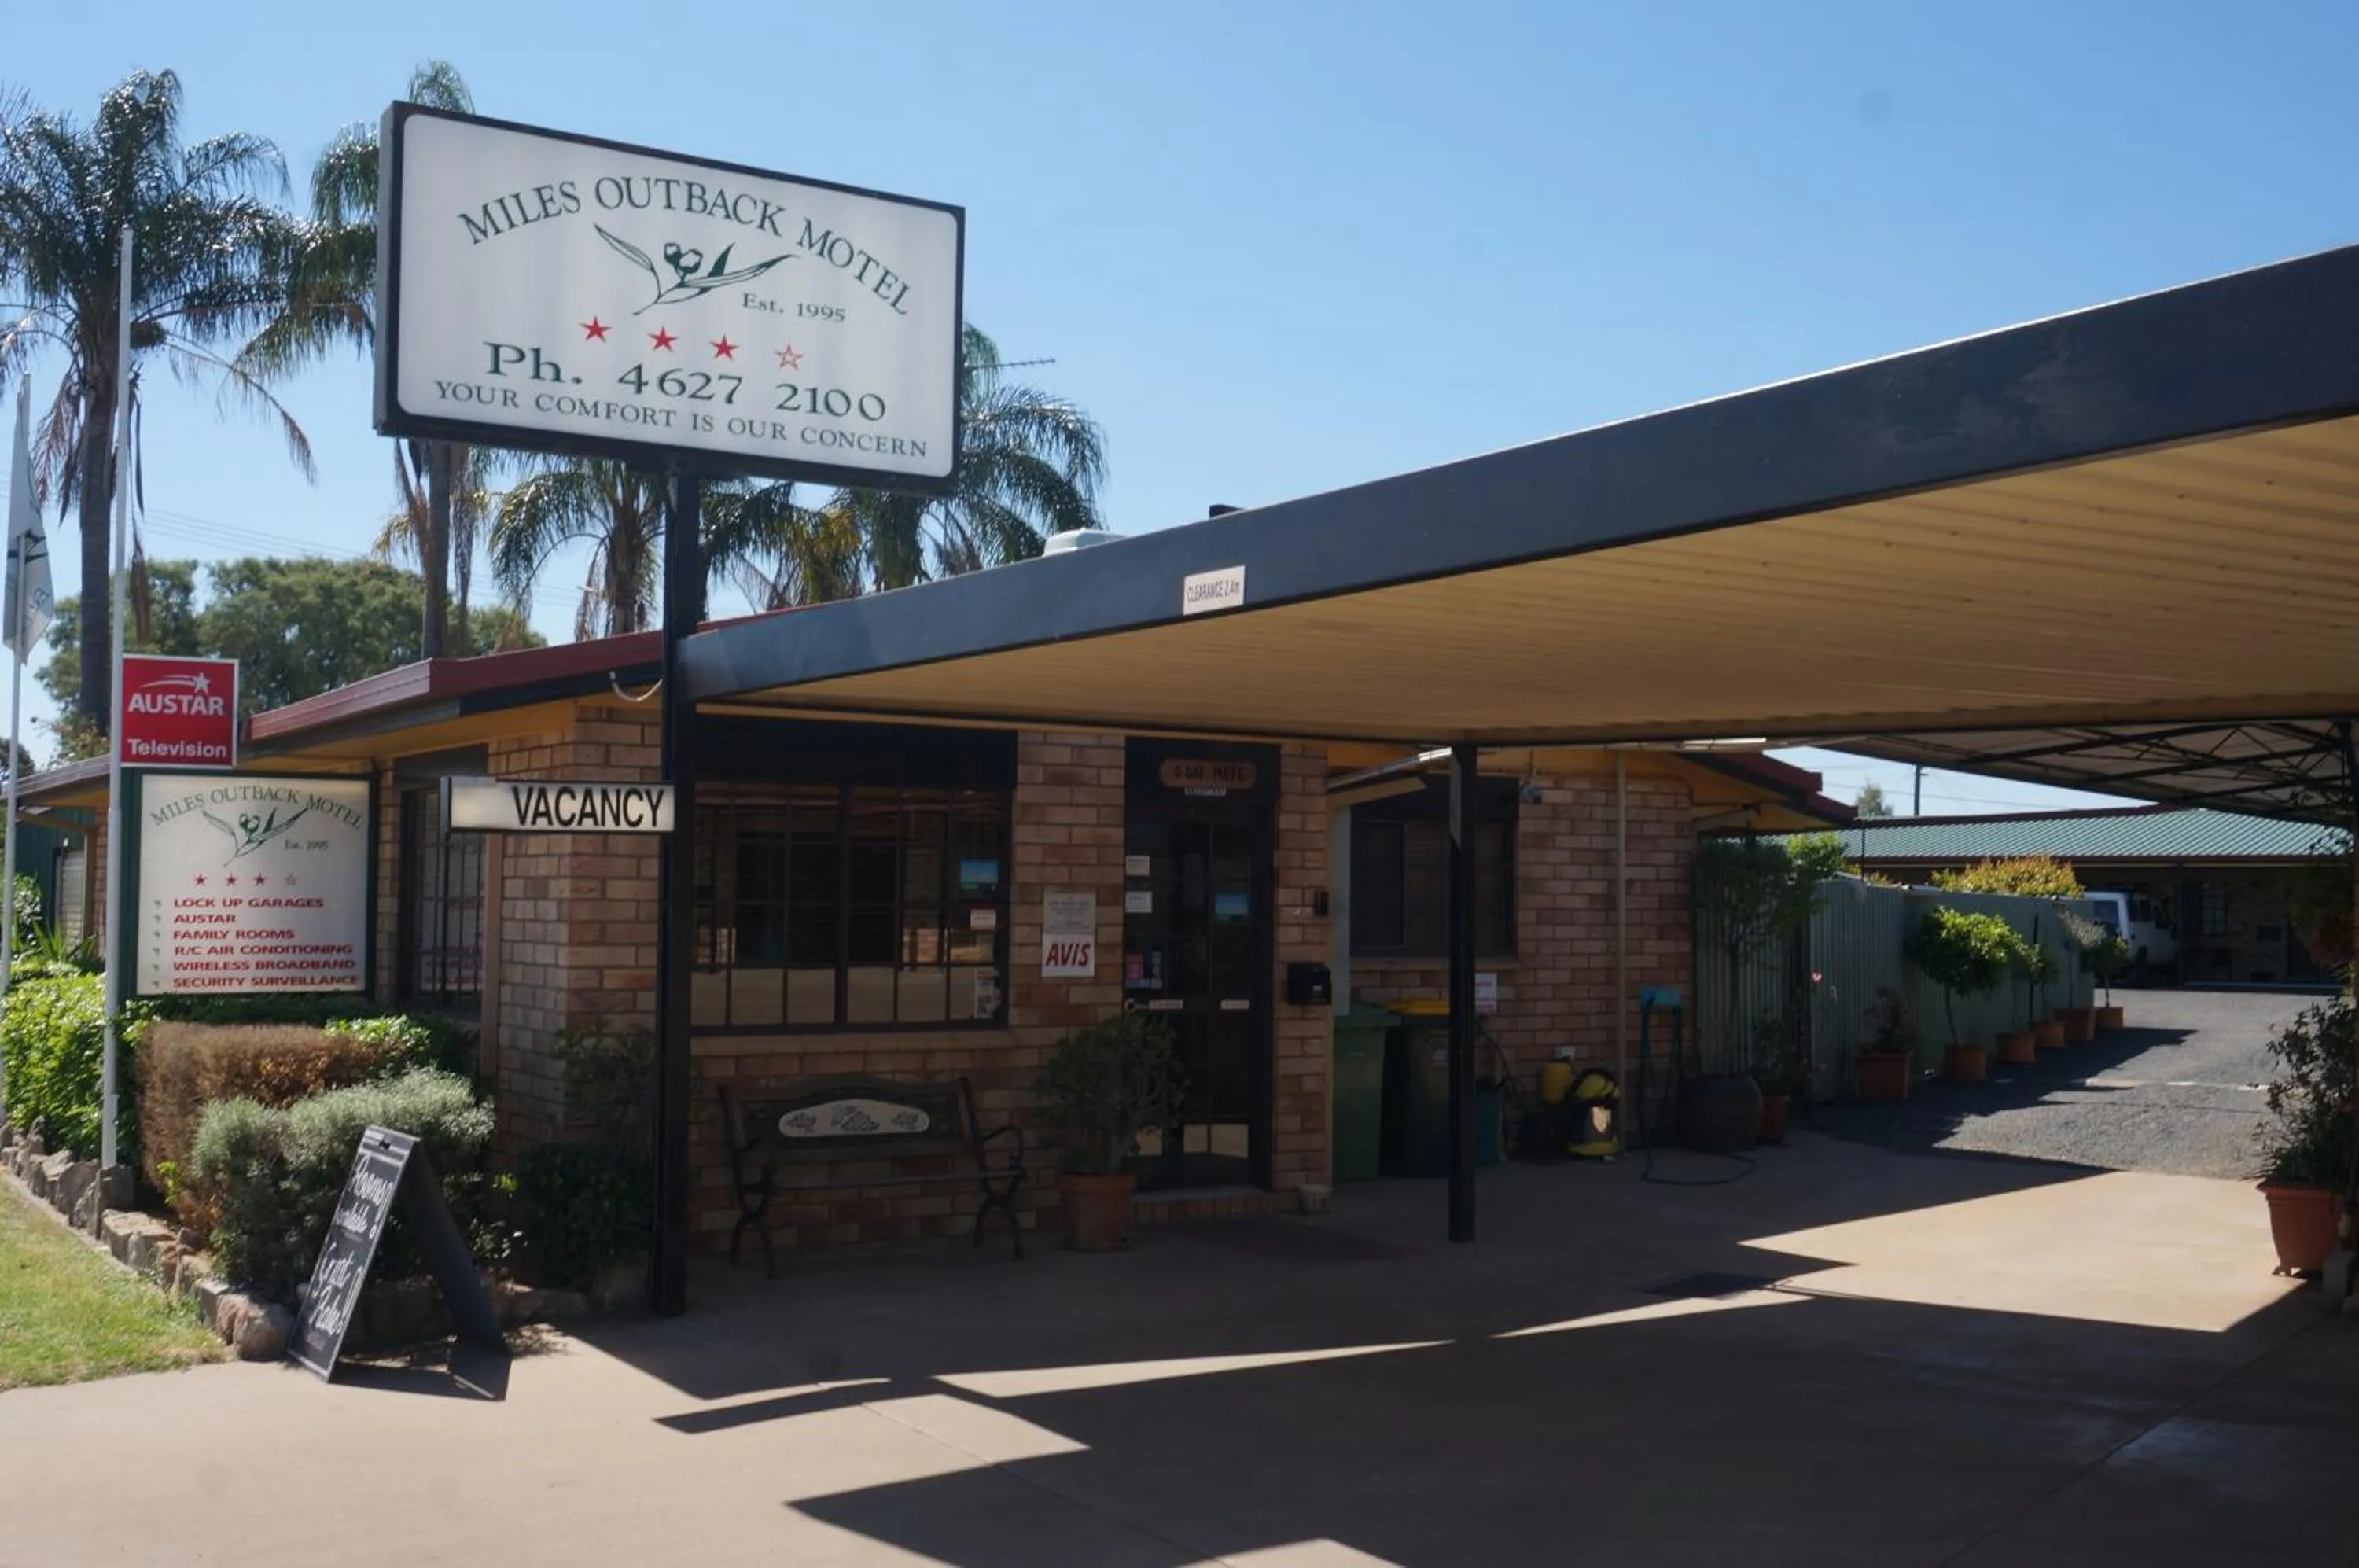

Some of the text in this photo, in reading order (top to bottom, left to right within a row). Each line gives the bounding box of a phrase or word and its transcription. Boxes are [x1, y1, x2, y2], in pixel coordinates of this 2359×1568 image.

[458, 176, 911, 315] MILES OUTBACK MOTEL
[742, 291, 846, 322] Est. 1995
[483, 341, 887, 421] Ph. 4627 2100
[435, 380, 927, 458] YOUR COMFORT IS OUR CONCERN
[128, 693, 224, 715] AUSTAR
[127, 738, 226, 758] Television
[150, 786, 362, 830] MILES OUTBACK MOTEL
[512, 786, 664, 828] VACANCY
[173, 898, 324, 908] LOCK UP GARAGES
[173, 915, 237, 924] AUSTAR
[173, 930, 295, 940] FAMILY ROOMS
[175, 944, 353, 955] R/C AIR CONDITIONING
[1046, 943, 1091, 967] AVIS
[173, 959, 356, 971] WIRELESS BROADBAND
[173, 976, 358, 988] SECURITY SURVEILLANCE
